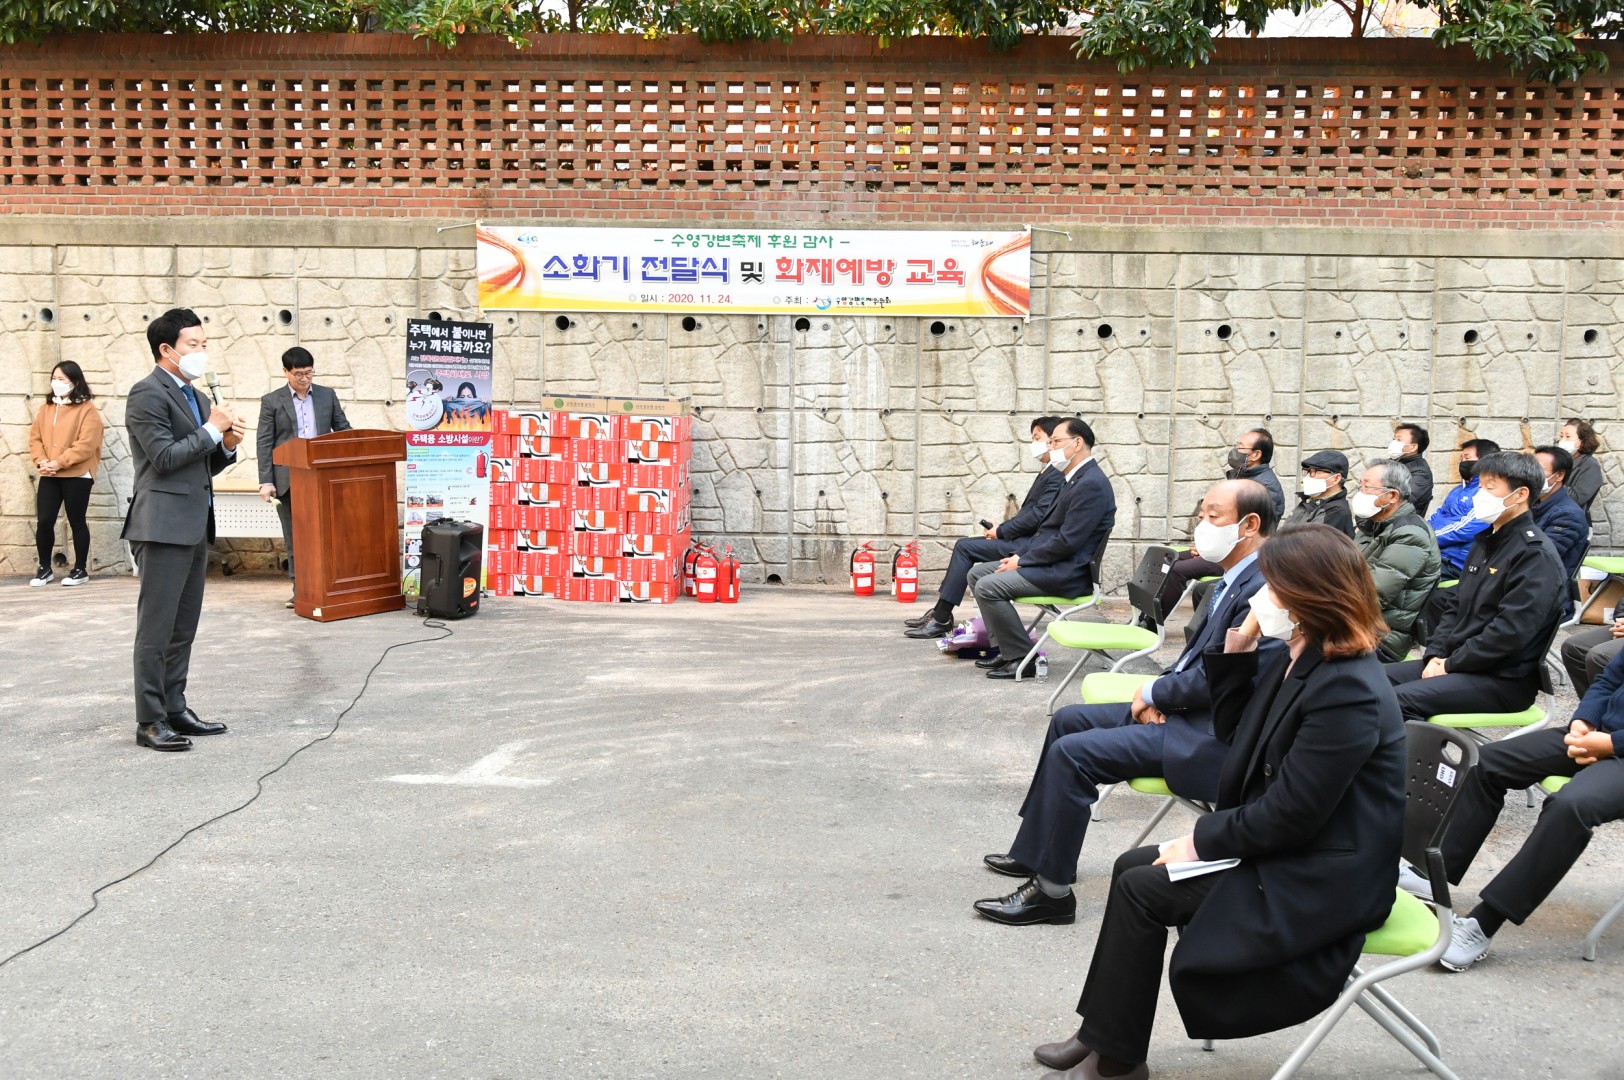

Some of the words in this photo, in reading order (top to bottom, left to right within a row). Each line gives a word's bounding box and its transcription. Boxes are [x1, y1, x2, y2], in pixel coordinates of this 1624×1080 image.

[671, 234, 761, 248] 수영강변축제
[768, 234, 797, 249] 후원
[803, 235, 834, 249] 감사
[542, 254, 629, 282] 소화기
[641, 256, 729, 283] 전달식
[740, 261, 763, 283] 및
[776, 256, 896, 286] 화재예방
[906, 257, 966, 286] 교육
[640, 294, 658, 303] 일시
[668, 294, 696, 304] 2020.
[700, 294, 715, 304] 11.
[718, 294, 734, 304] 24.
[784, 296, 802, 305] 주최
[409, 324, 448, 338] 주택에서
[452, 326, 487, 340] 불이나면
[408, 340, 428, 352] 누가
[430, 340, 492, 354] 깨워줄까요?
[412, 434, 436, 444] 주택용
[438, 434, 484, 444] 소방시설이란?
